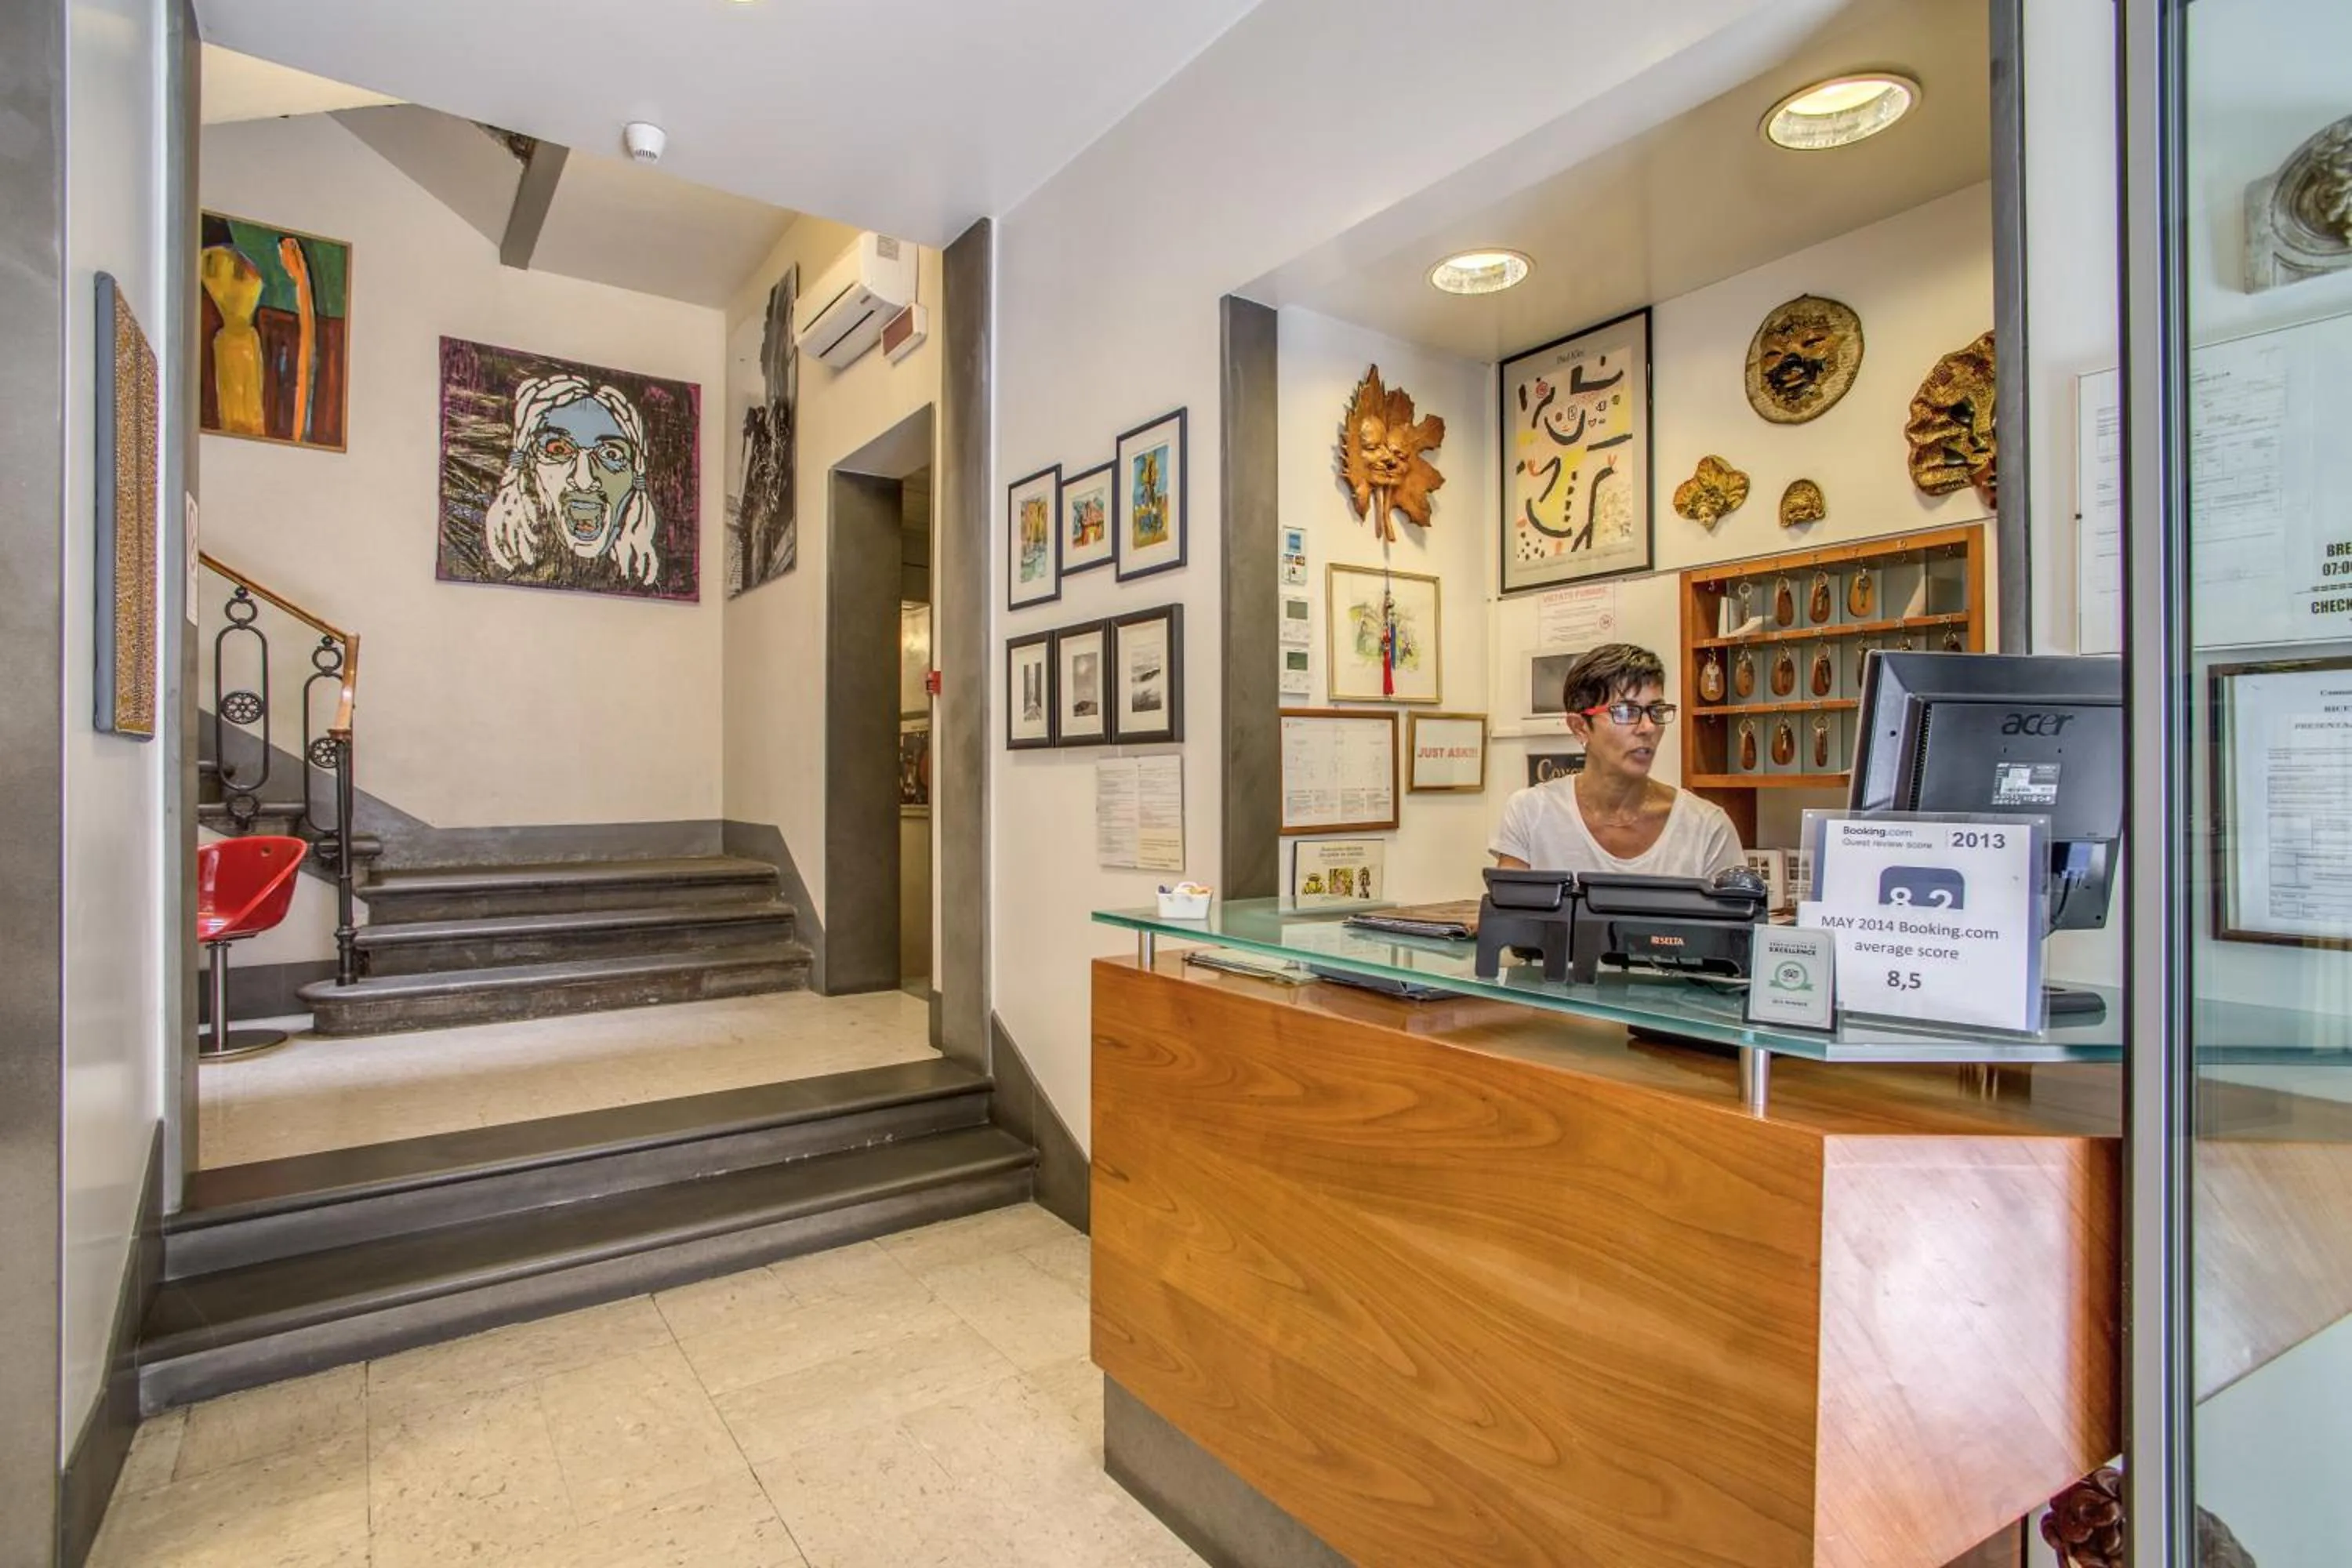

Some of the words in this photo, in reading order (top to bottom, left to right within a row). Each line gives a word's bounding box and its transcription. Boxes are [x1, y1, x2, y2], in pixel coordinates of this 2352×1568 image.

[2323, 561, 2352, 575] 07:0
[2001, 713, 2074, 736] acer
[1417, 747, 1444, 758] JUST
[1843, 826, 1912, 837] Booking.com
[1951, 832, 2005, 849] 2013
[1820, 916, 1855, 929] MAY
[1858, 918, 1895, 932] 2014
[1899, 921, 1999, 940] Booking.com
[1854, 942, 1914, 957] average
[1918, 946, 1959, 959] score
[1886, 970, 1922, 991] 8,5
